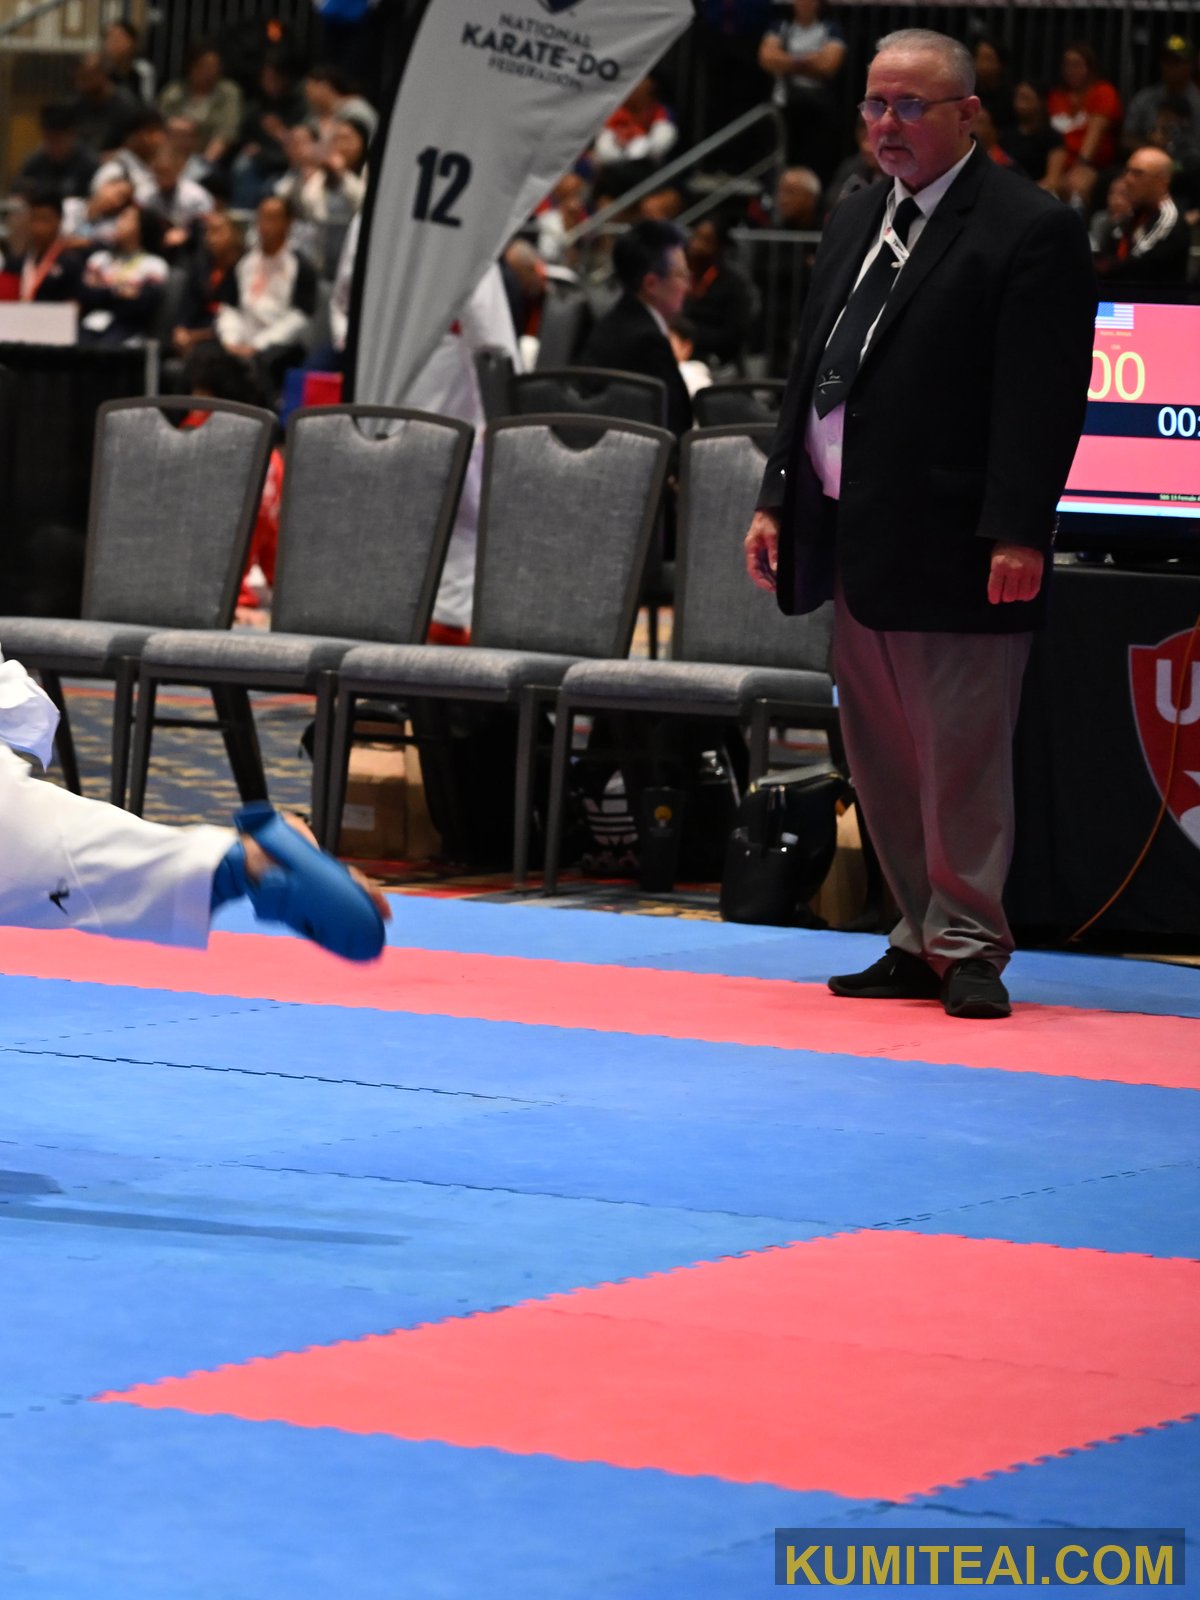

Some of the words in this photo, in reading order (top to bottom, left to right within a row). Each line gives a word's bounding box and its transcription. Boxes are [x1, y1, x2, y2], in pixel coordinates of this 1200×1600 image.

[461, 22, 619, 82] KARATE-DO
[499, 12, 591, 48] NATIONAL
[487, 53, 583, 92] FEDERATION
[412, 145, 472, 228] 12
